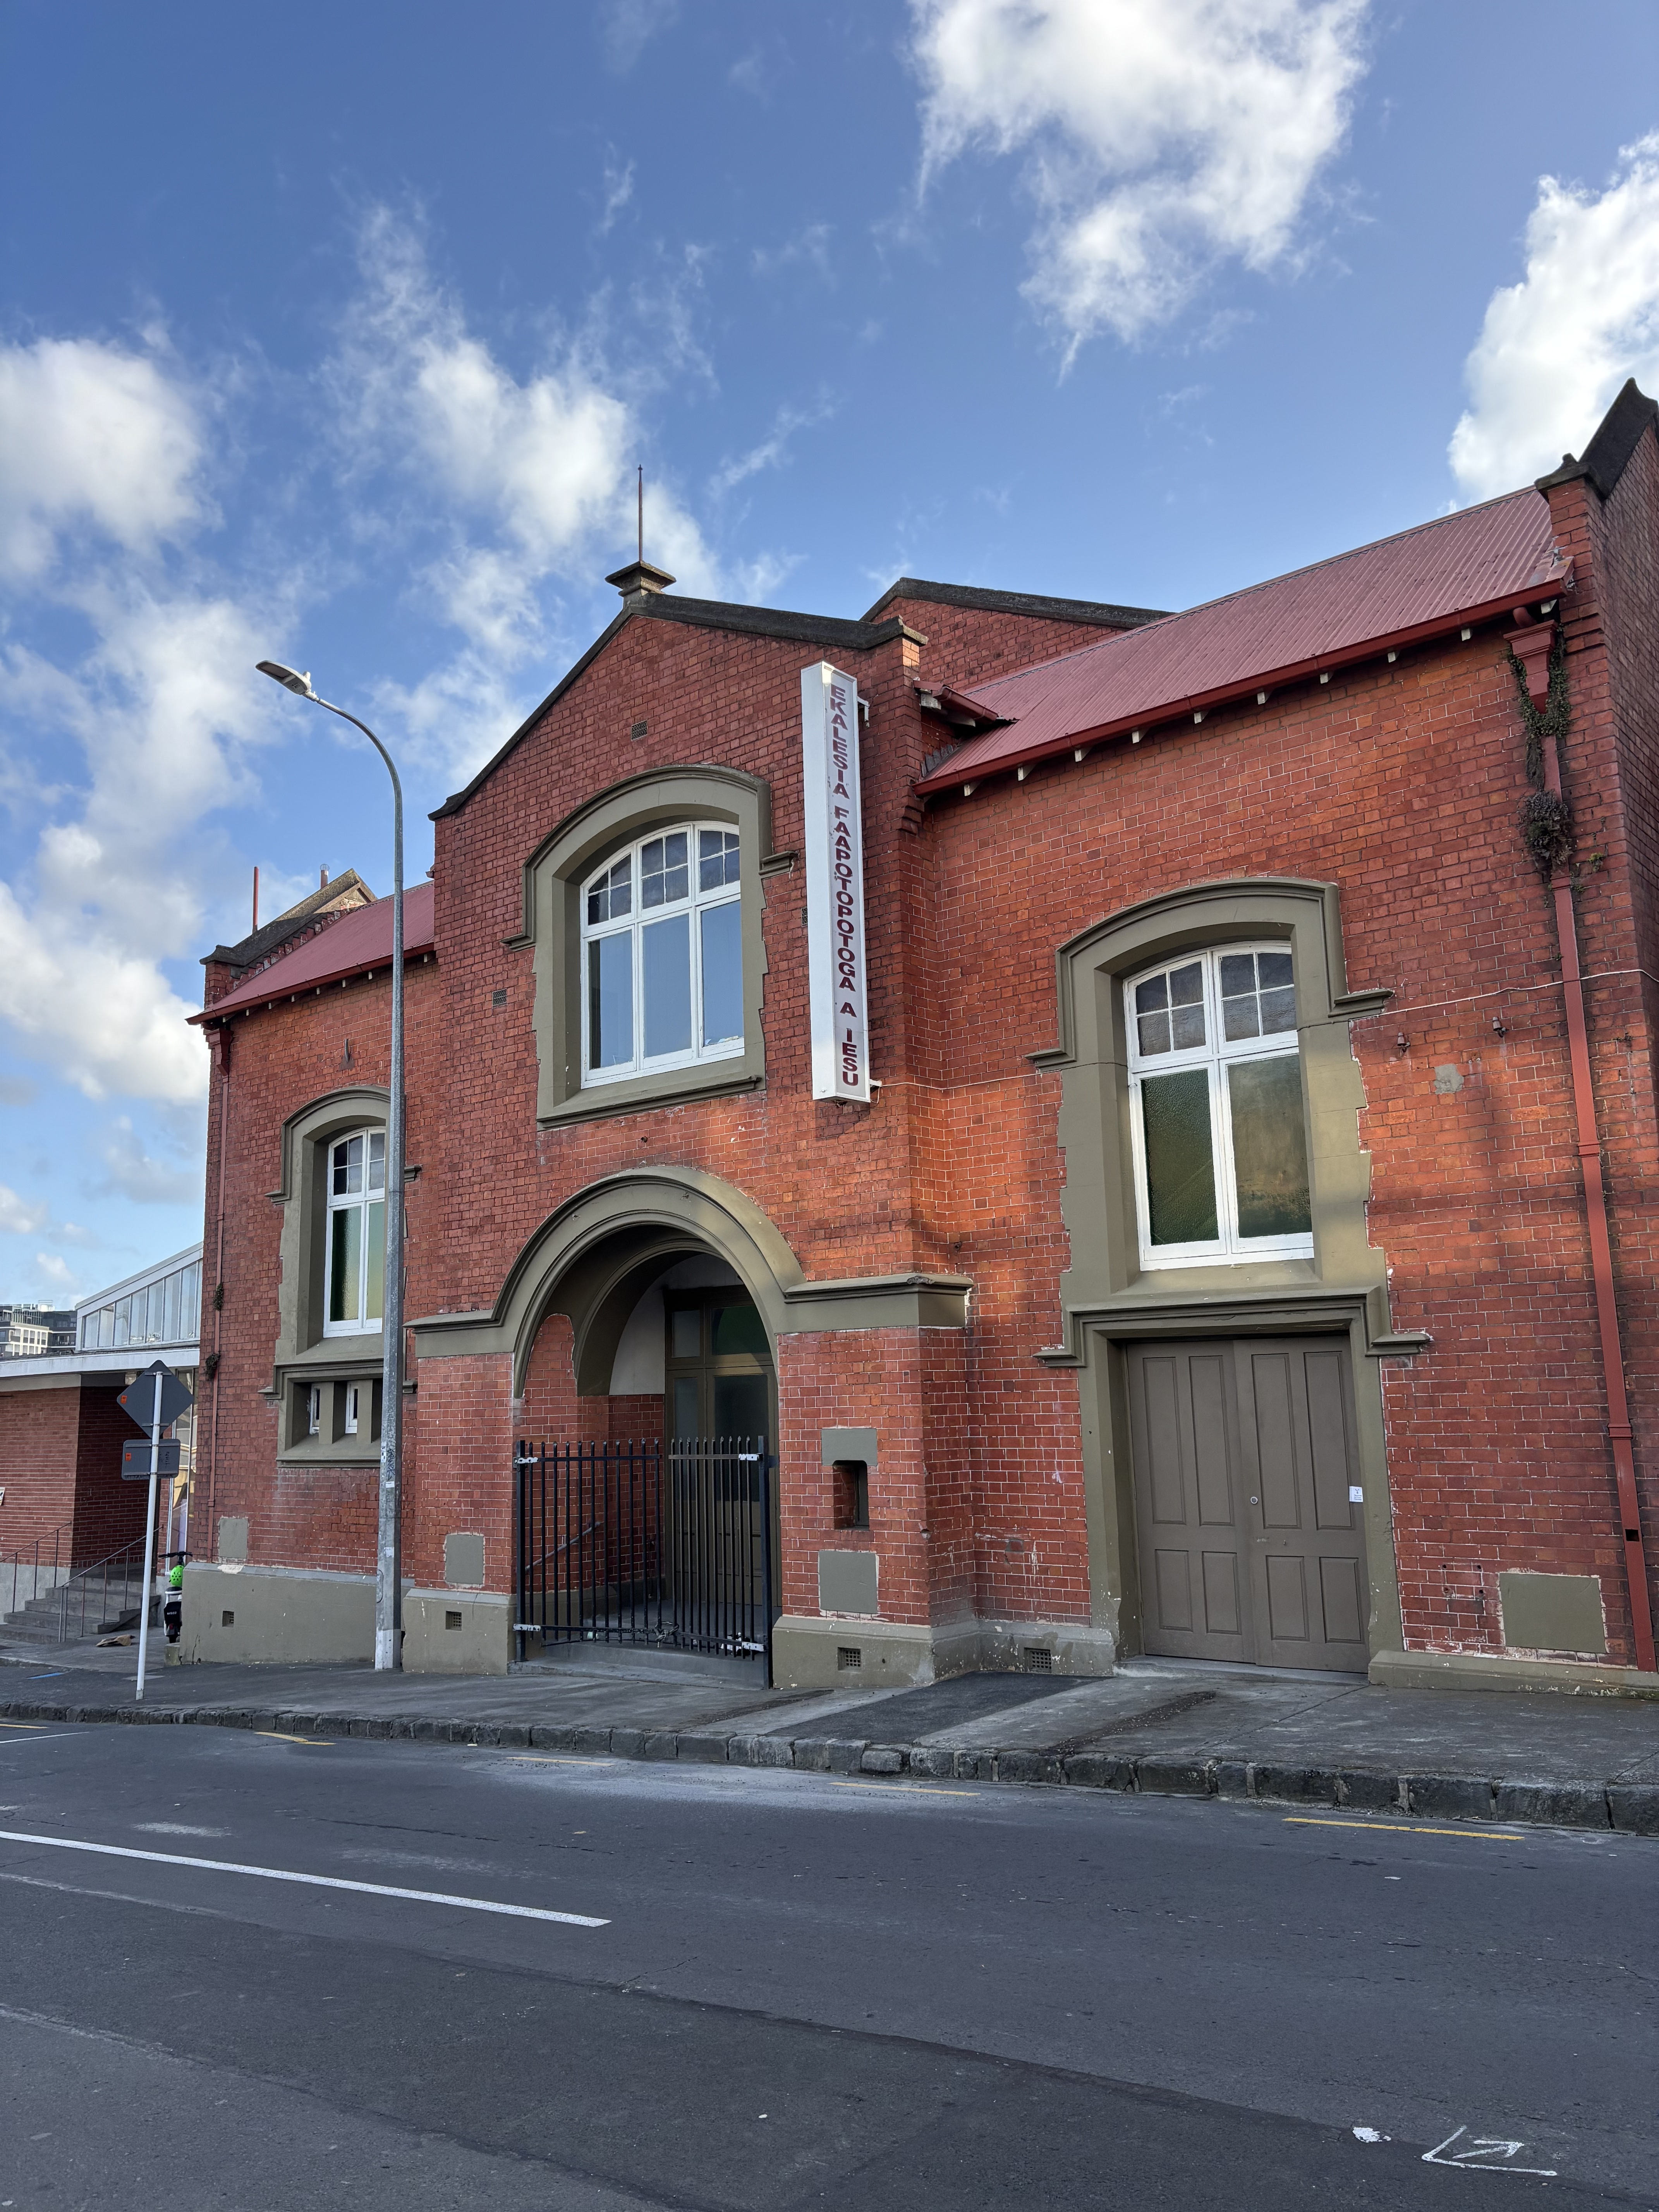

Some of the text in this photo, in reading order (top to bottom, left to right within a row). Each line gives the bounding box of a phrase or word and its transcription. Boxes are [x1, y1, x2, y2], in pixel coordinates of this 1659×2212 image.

[830, 684, 859, 1086] EKALESIA FAAPOTOPOTOGA A IESU
